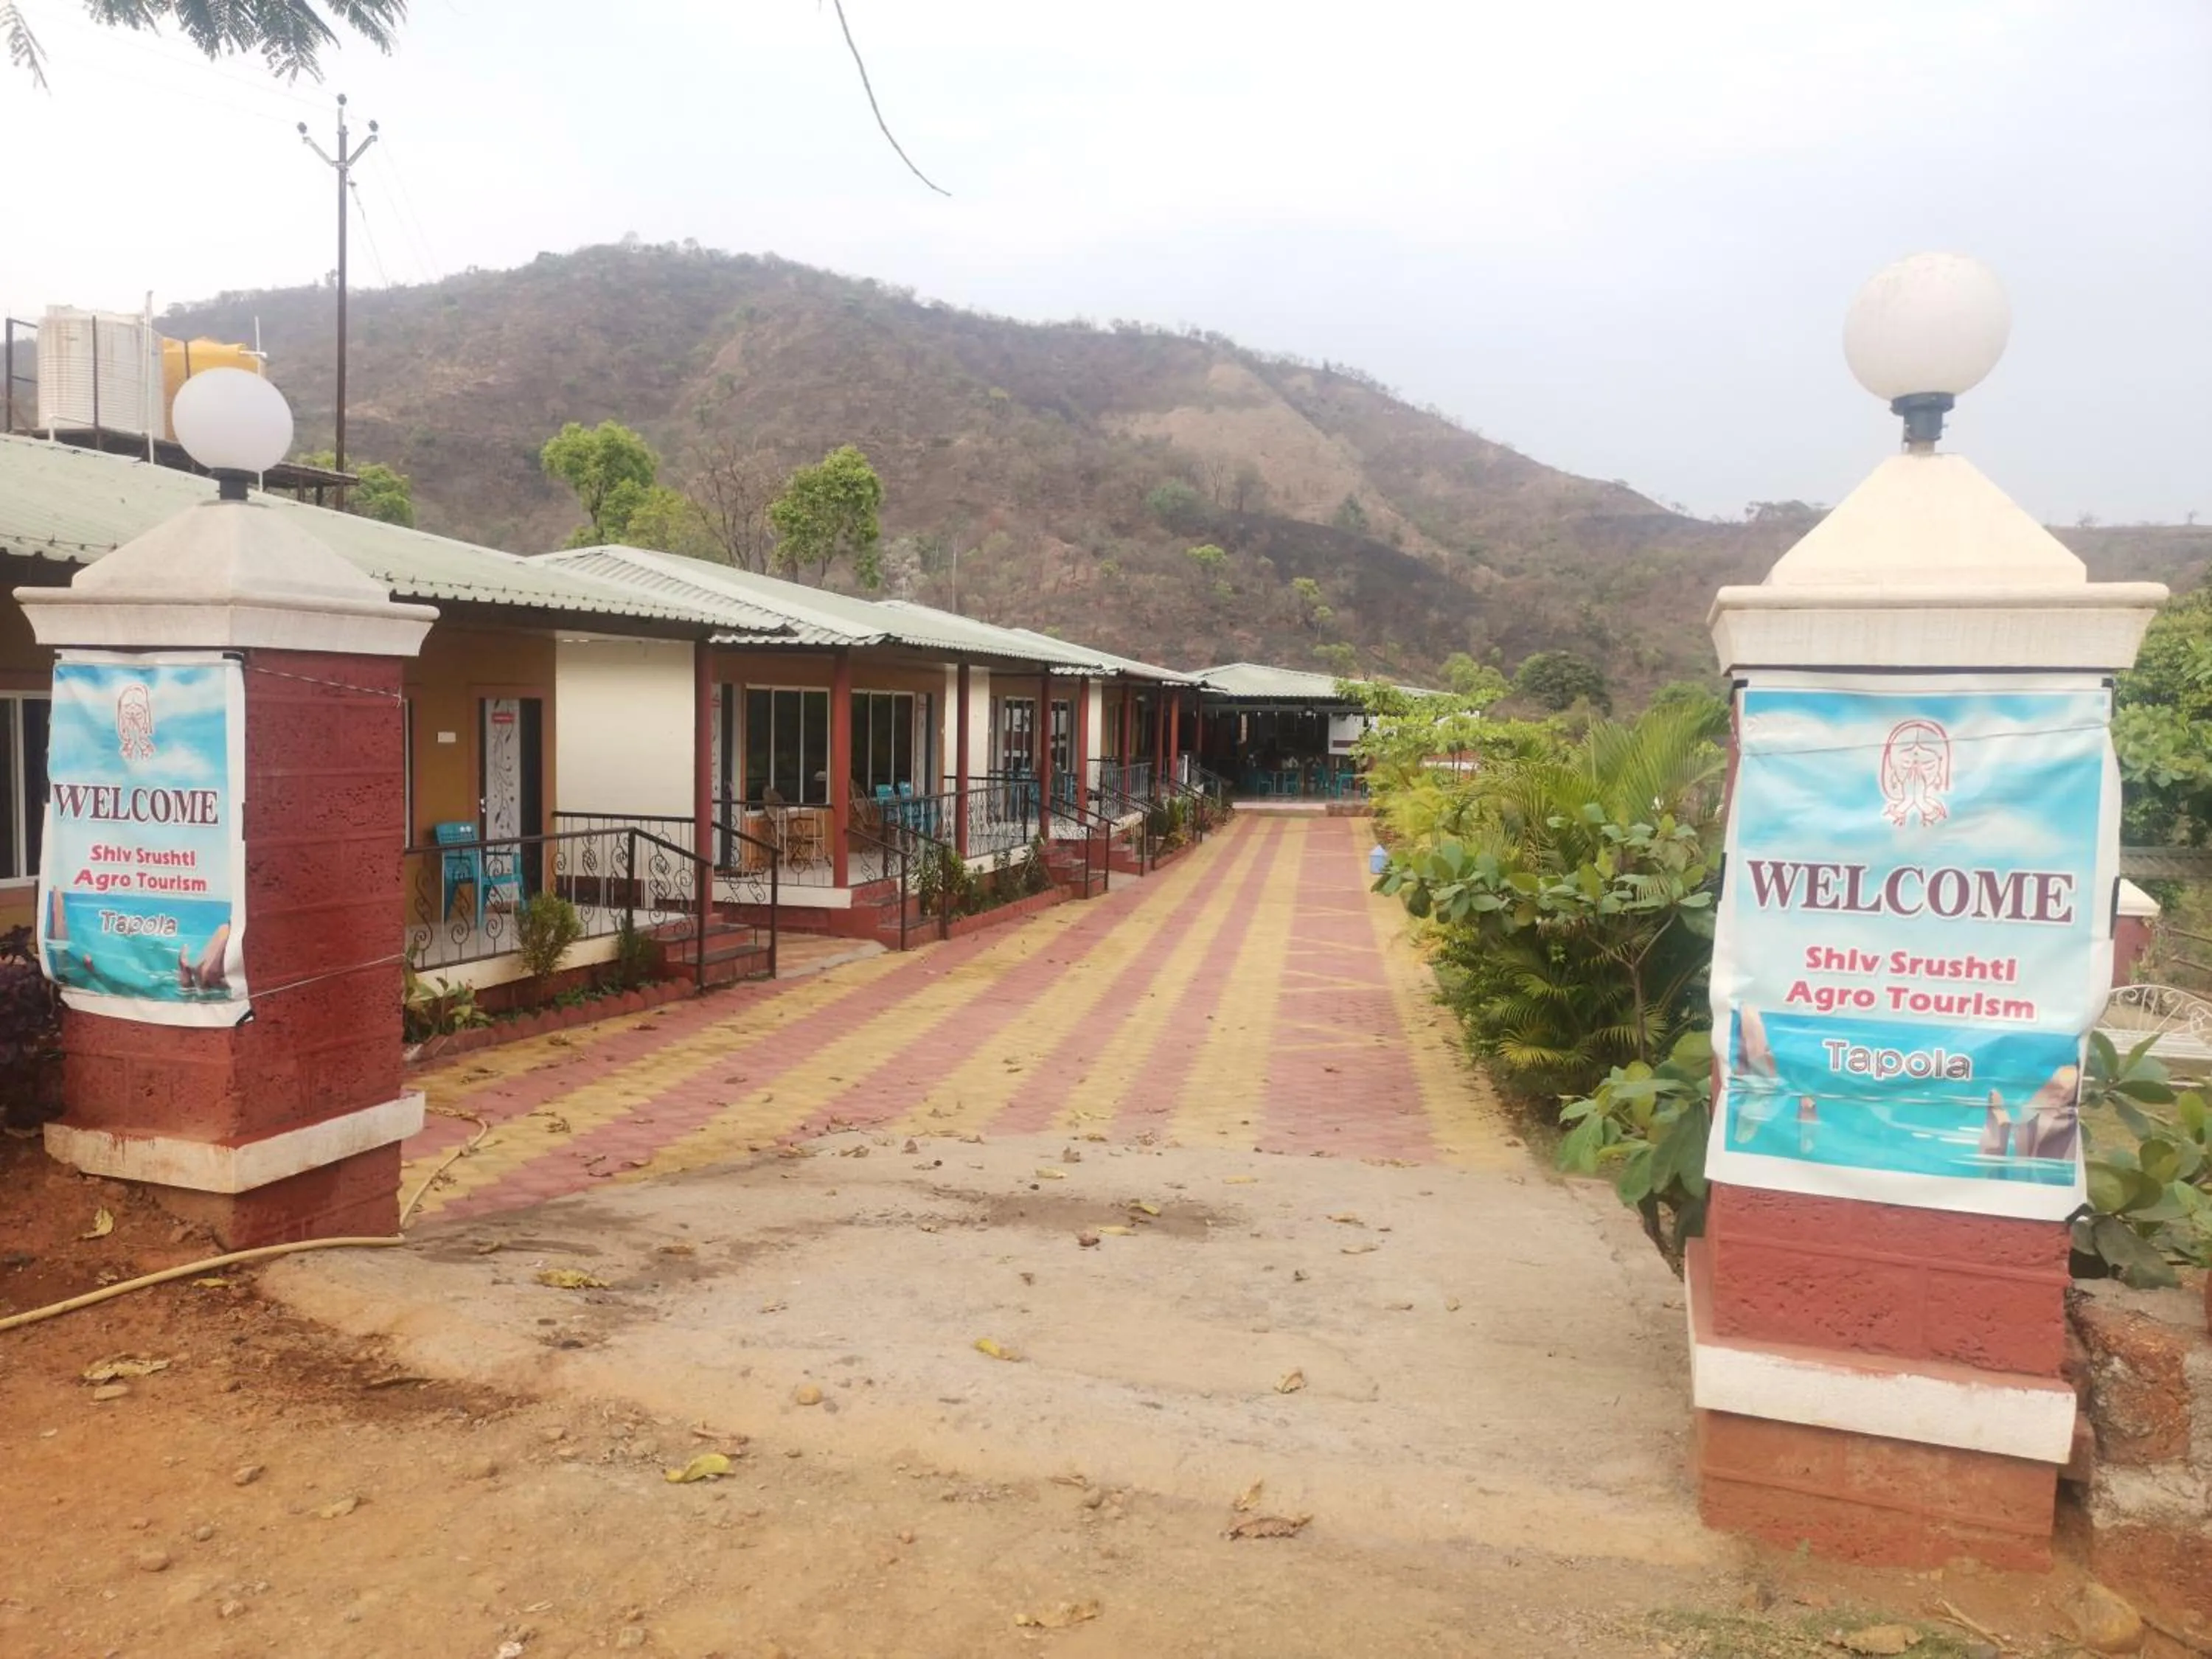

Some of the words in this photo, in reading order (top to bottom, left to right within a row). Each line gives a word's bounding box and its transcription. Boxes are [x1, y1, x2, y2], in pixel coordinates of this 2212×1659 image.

[54, 784, 219, 824] WELCOME
[74, 869, 131, 891] Agro
[136, 872, 207, 891] Tourism
[1747, 860, 2073, 923] WELCOME
[100, 911, 177, 934] Tapola
[1806, 946, 1879, 973] Shiv
[1787, 981, 1875, 1012] Agro
[1886, 987, 2034, 1019] Tourism
[1824, 1040, 1971, 1079] Tapola
